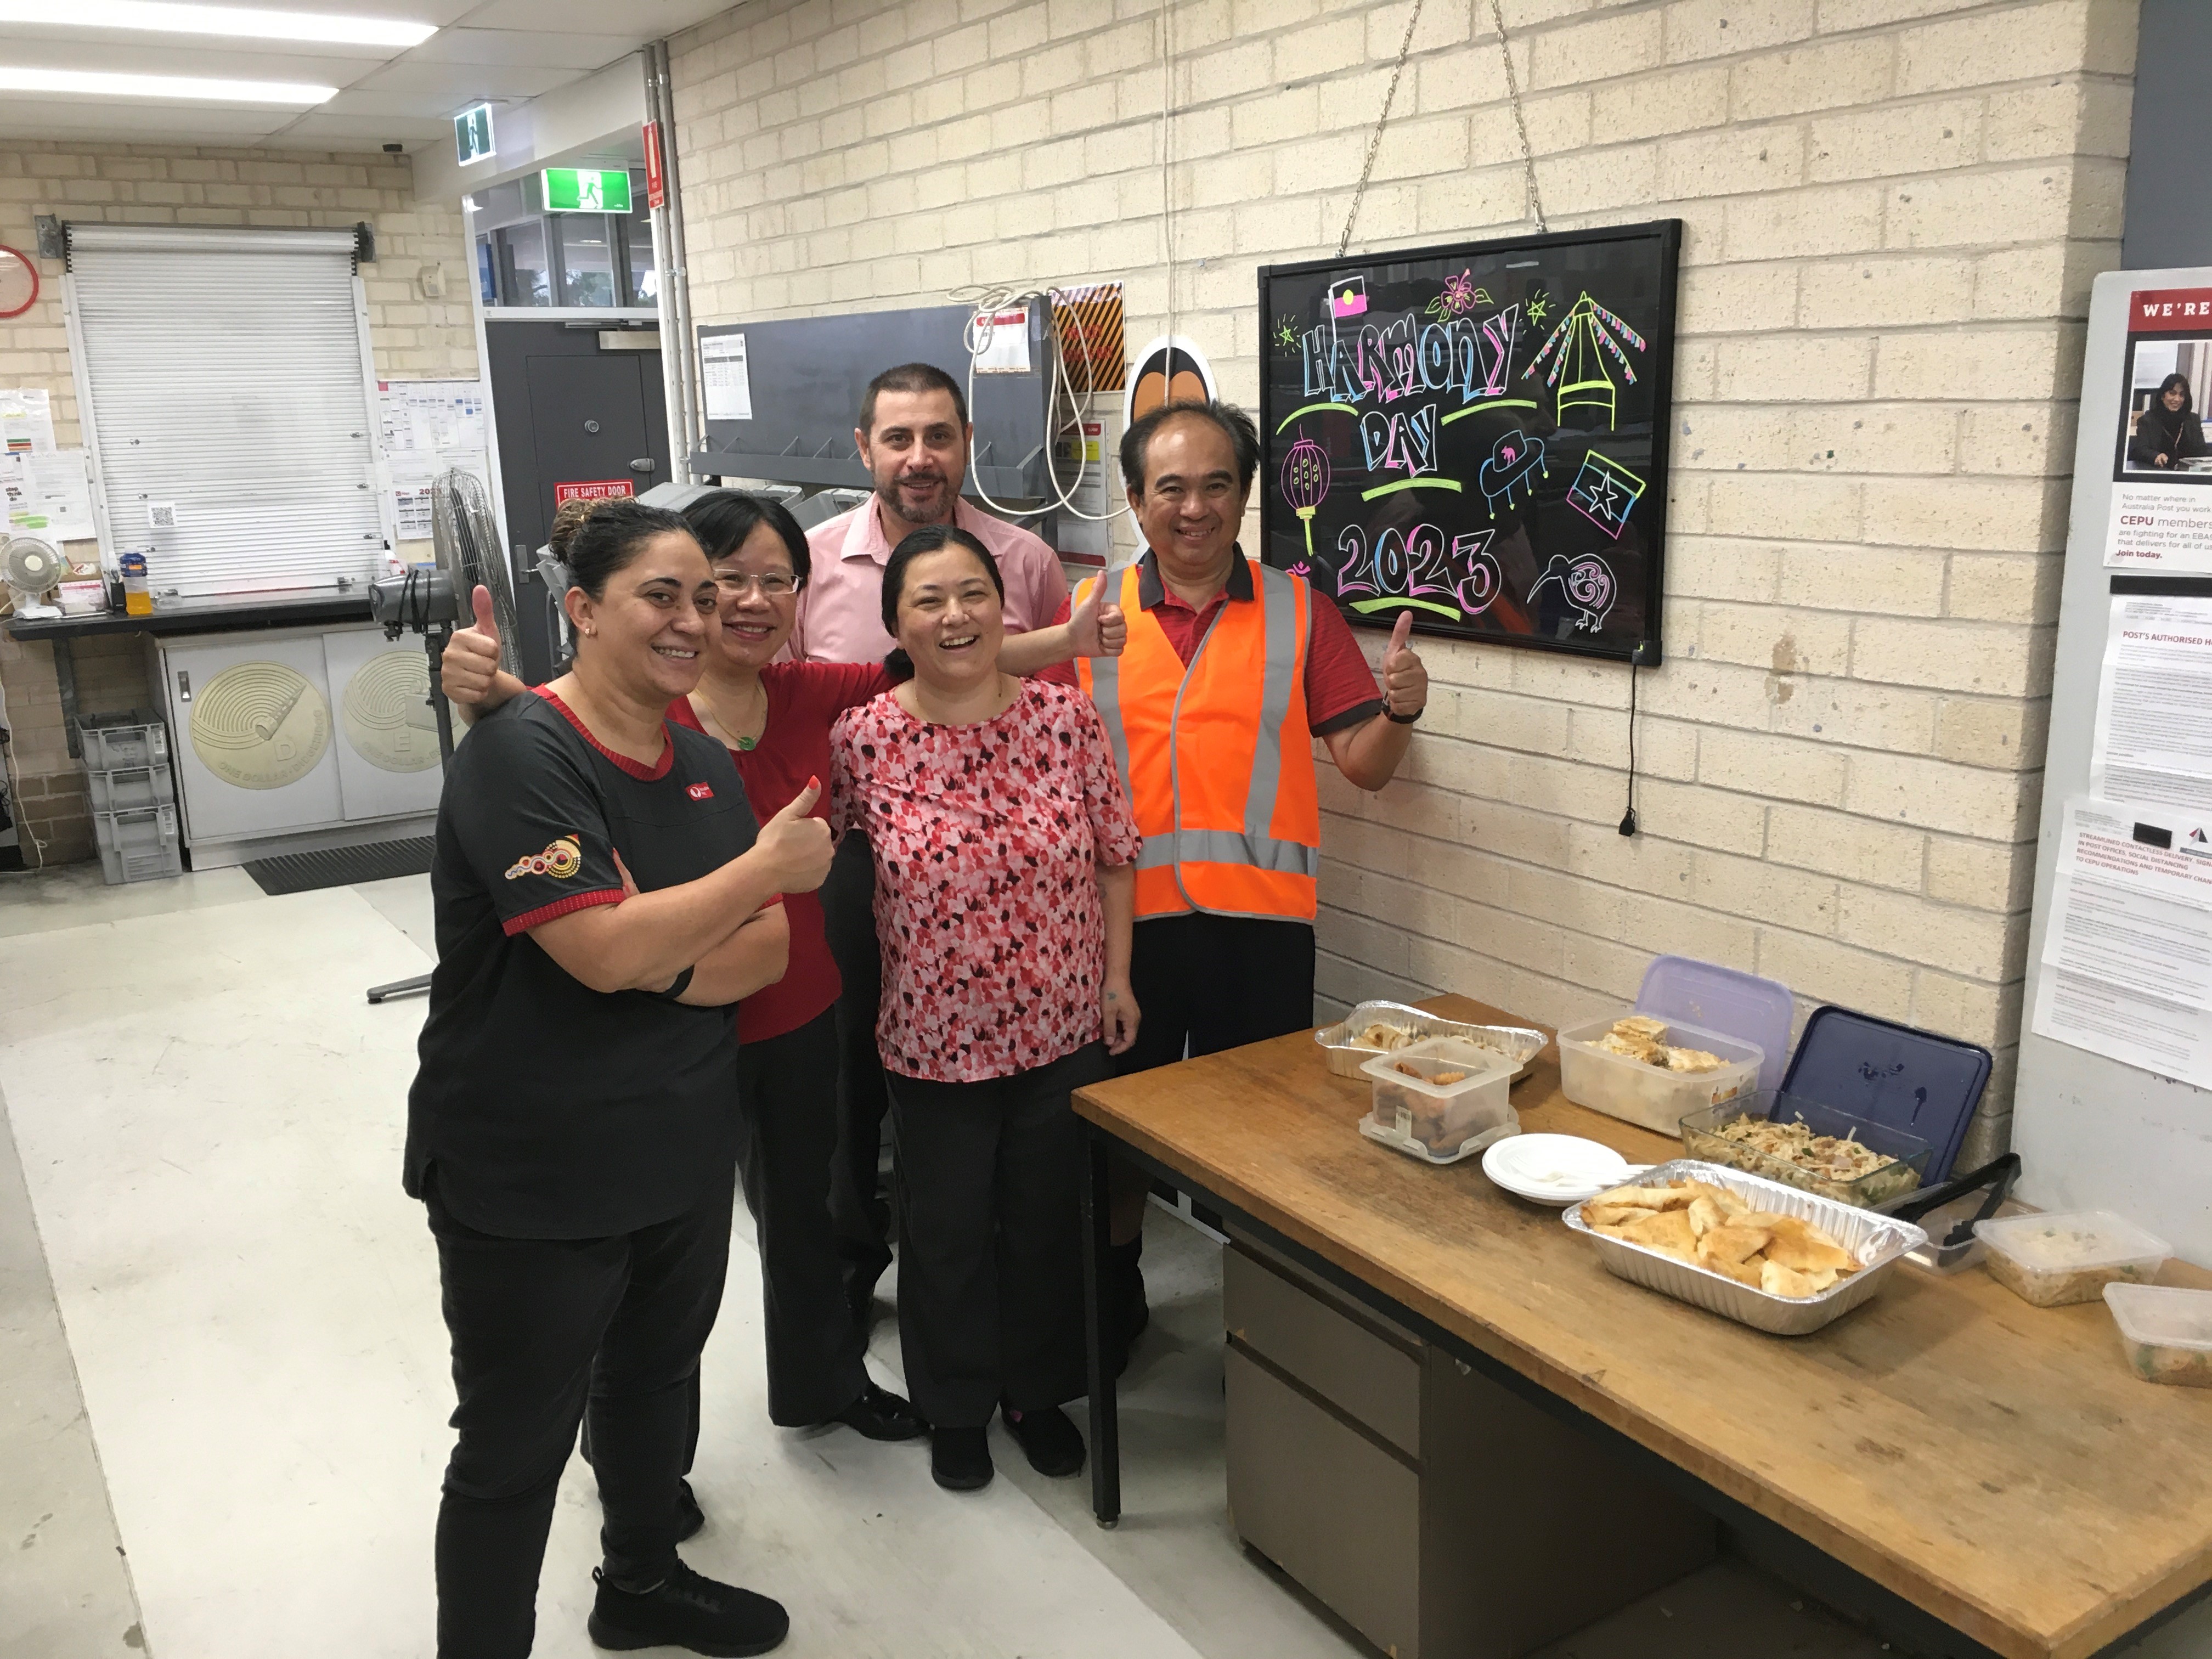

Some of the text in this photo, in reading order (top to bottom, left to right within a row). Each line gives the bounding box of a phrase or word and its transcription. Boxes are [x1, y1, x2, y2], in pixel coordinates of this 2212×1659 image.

[2143, 302, 2210, 317] WE'RE
[1359, 404, 1437, 478] DAY
[563, 485, 627, 498] FIRE SAFETY DOOR
[2120, 515, 2212, 529] CEPU members
[2133, 529, 2164, 539] fighting
[2135, 539, 2166, 548] delivers
[2136, 550, 2163, 560] today.
[1338, 524, 1502, 614] 2023
[2123, 631, 2149, 640] POST'S
[2151, 634, 2203, 645] AUTHORISED
[218, 761, 241, 778] ONE
[2079, 832, 2120, 845] STREAMLINED
[2121, 842, 2163, 855] CONTACTLESS
[2076, 848, 2138, 867] RECOMMENDATIONS
[2139, 862, 2153, 871] AND
[2154, 866, 2193, 880] TEMPORARY
[2129, 851, 2149, 861] SOCIAL
[2151, 857, 2188, 870] DISTANCING
[2101, 862, 2139, 876] OPERATIONS
